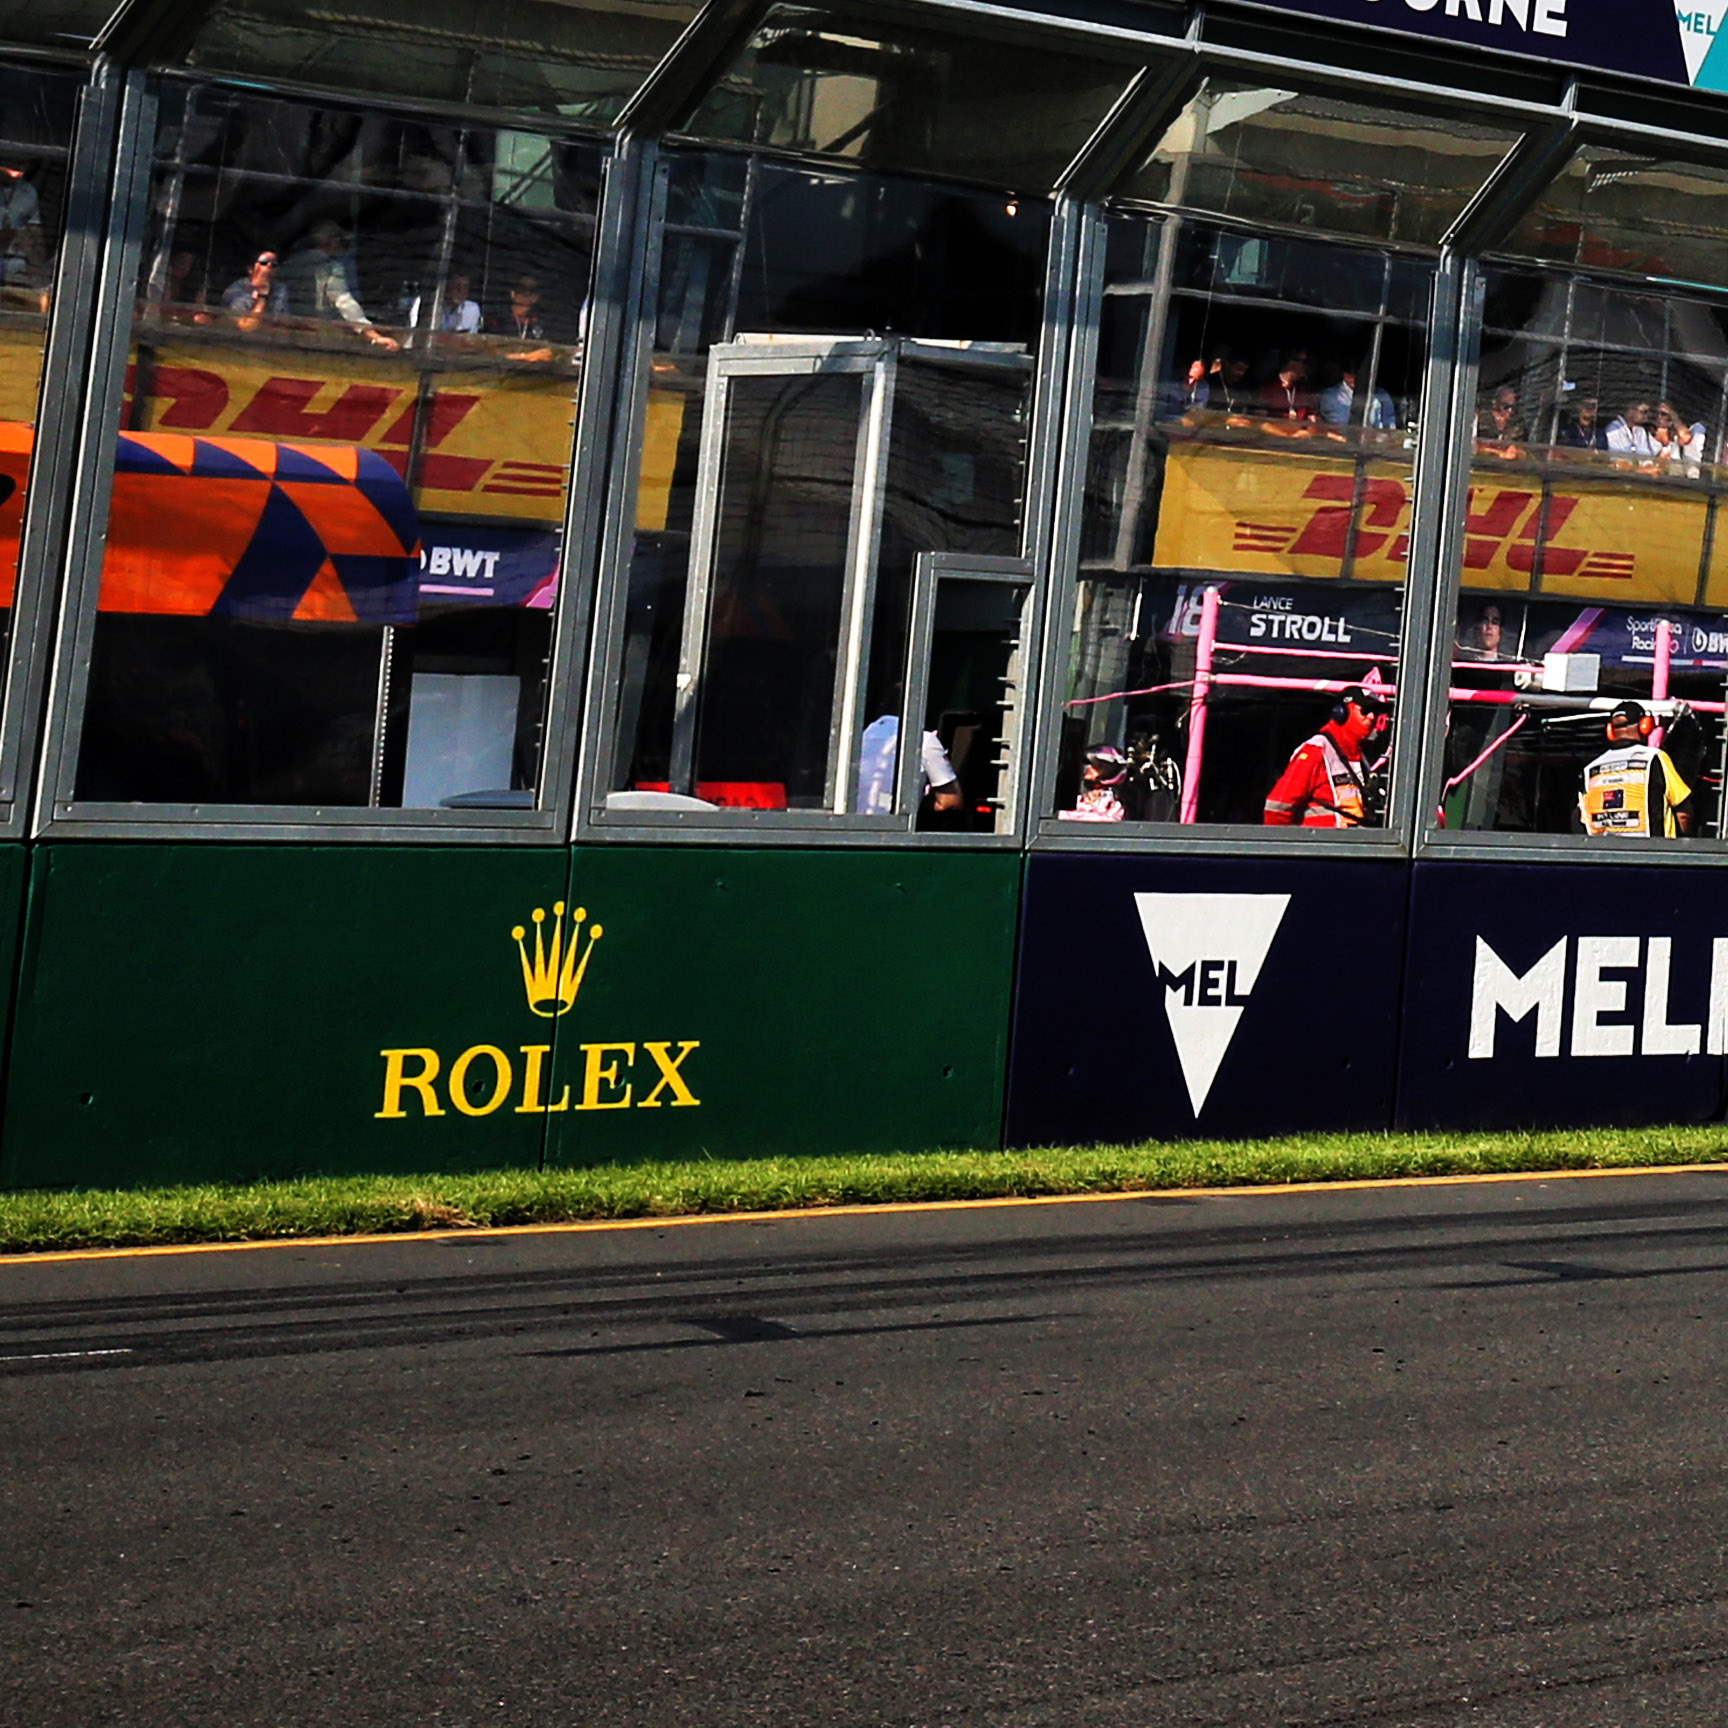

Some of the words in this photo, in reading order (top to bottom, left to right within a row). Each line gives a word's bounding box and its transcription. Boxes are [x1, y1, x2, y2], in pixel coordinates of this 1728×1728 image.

[1677, 9, 1717, 37] MEL
[429, 546, 500, 578] BWT
[1252, 595, 1294, 611] LANCE
[1249, 614, 1352, 644] STROLL
[1156, 958, 1253, 1009] MEL
[374, 1039, 703, 1120] ROLEX
